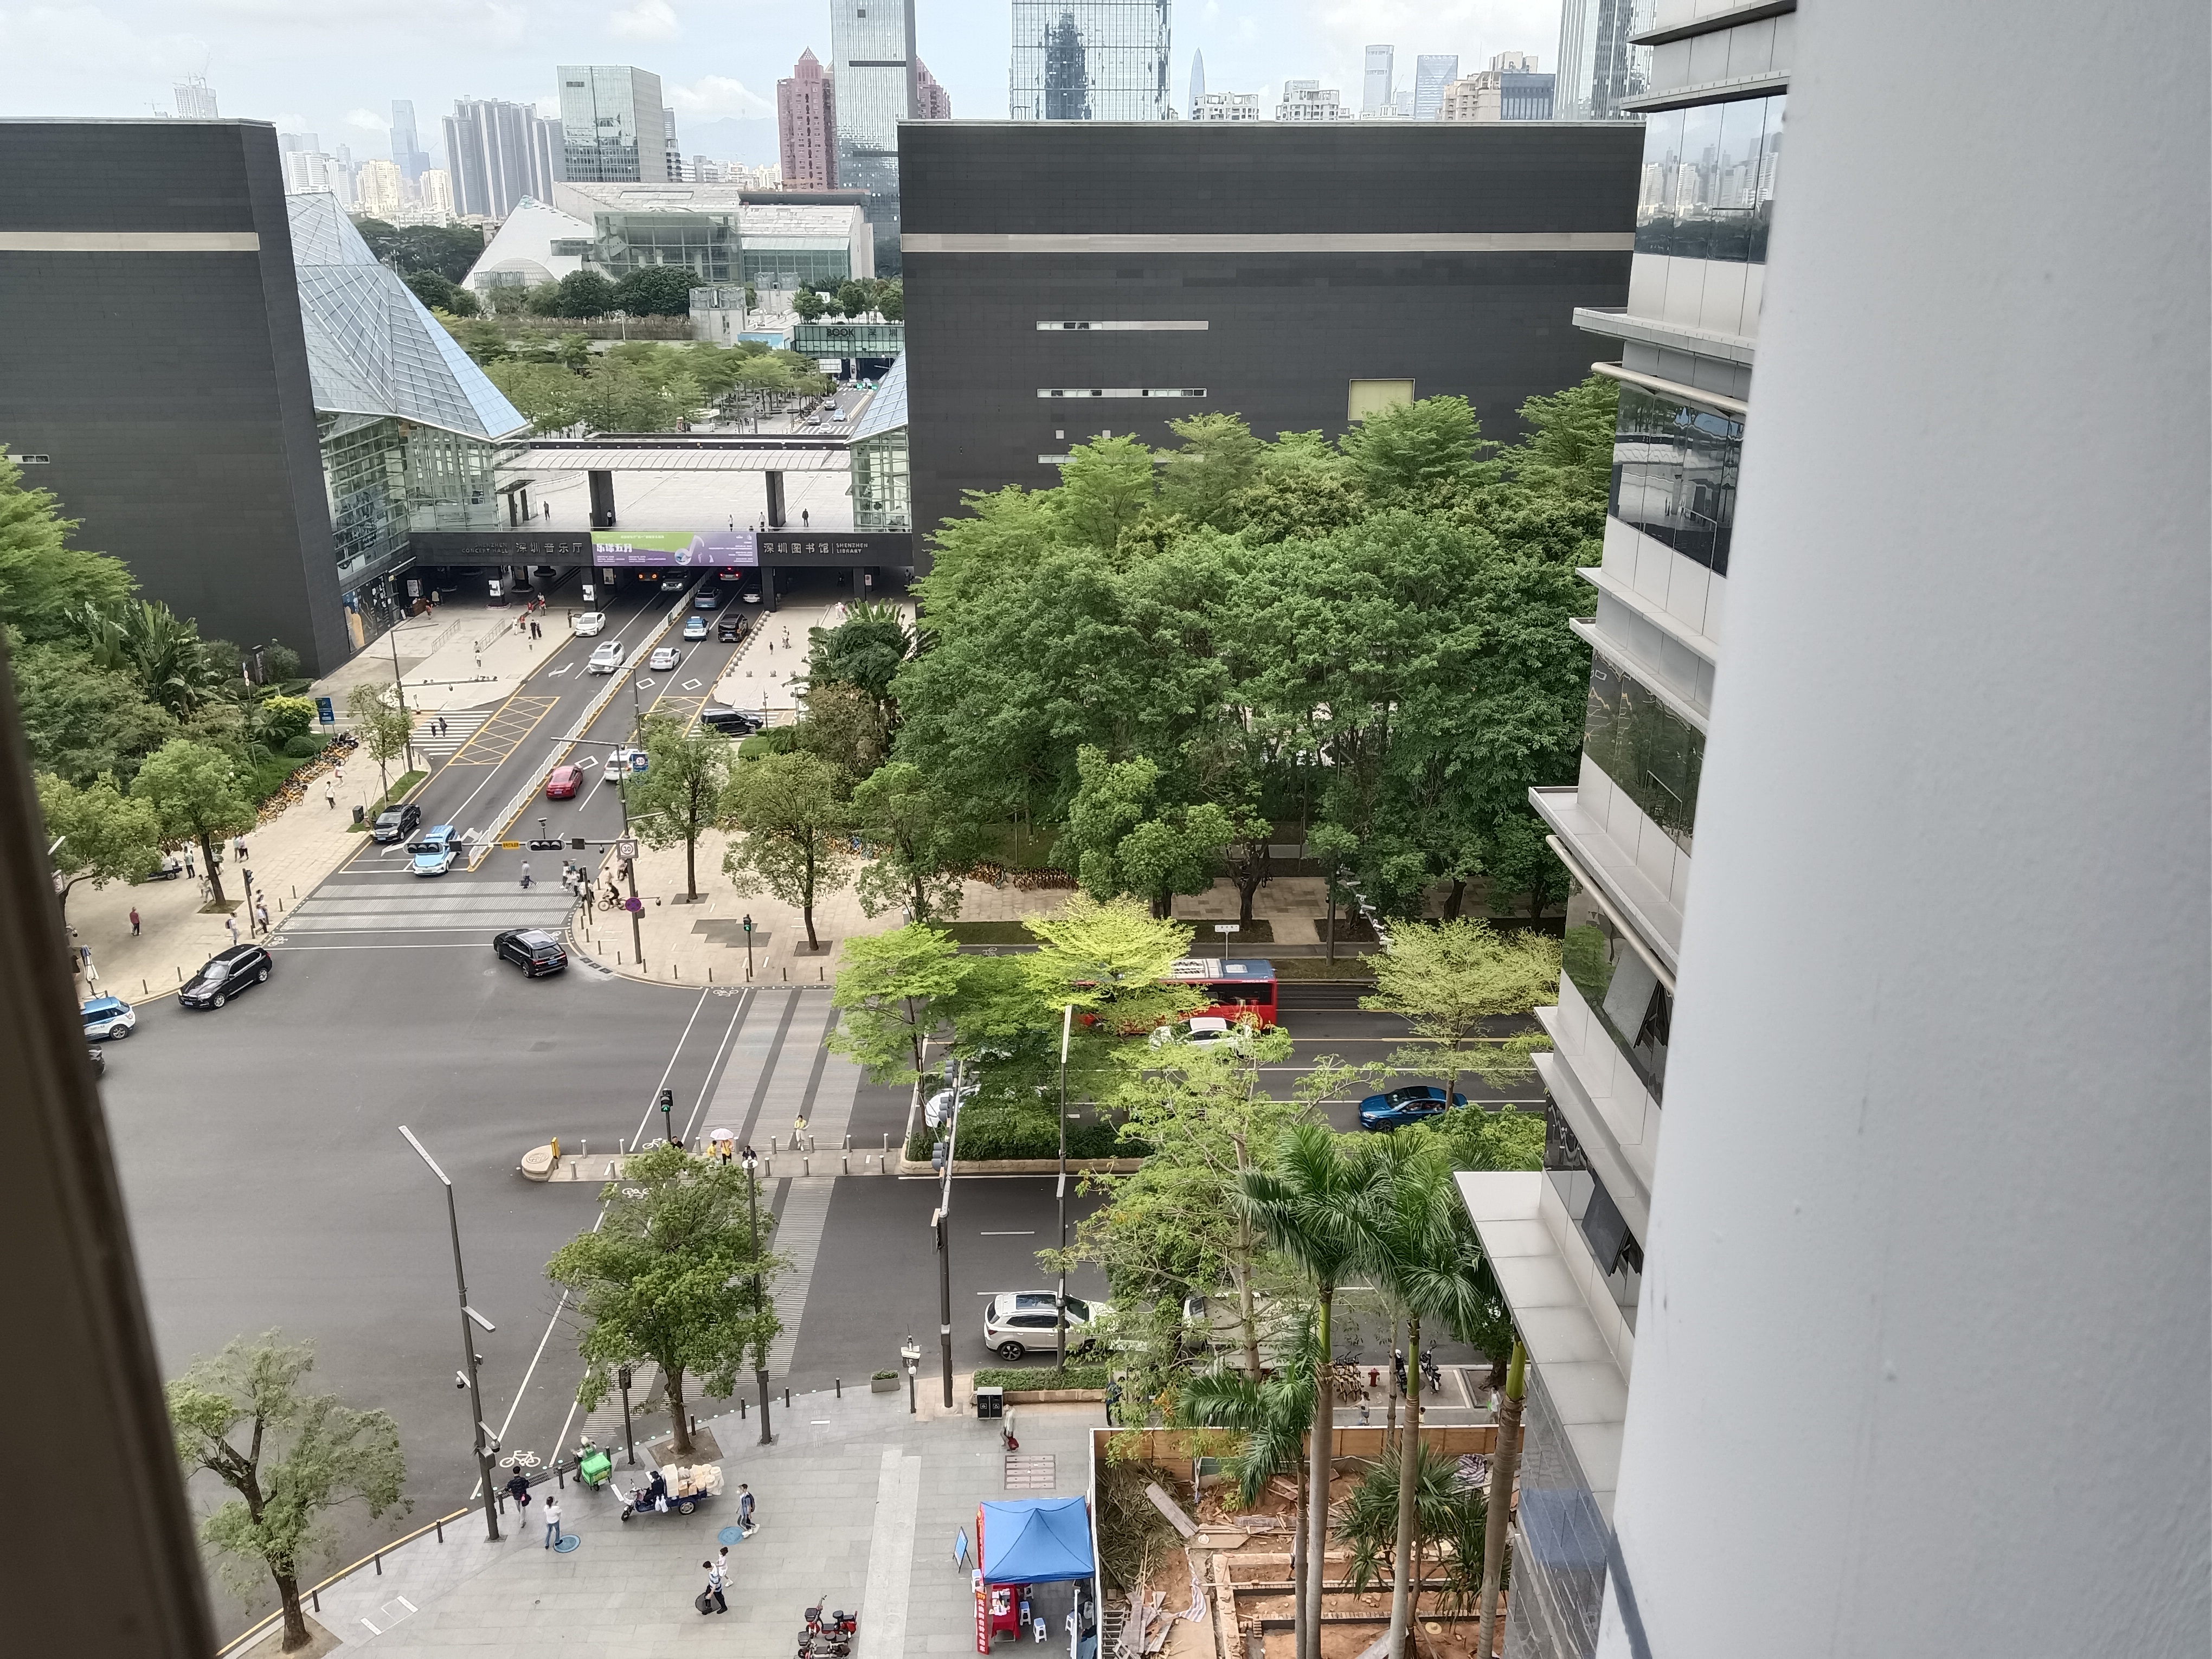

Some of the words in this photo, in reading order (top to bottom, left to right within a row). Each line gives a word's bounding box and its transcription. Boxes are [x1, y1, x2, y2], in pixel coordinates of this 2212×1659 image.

[827, 328, 854, 337] BOOK
[516, 543, 582, 554] 深圳音乐厅
[763, 543, 829, 554] 深圳图书馆
